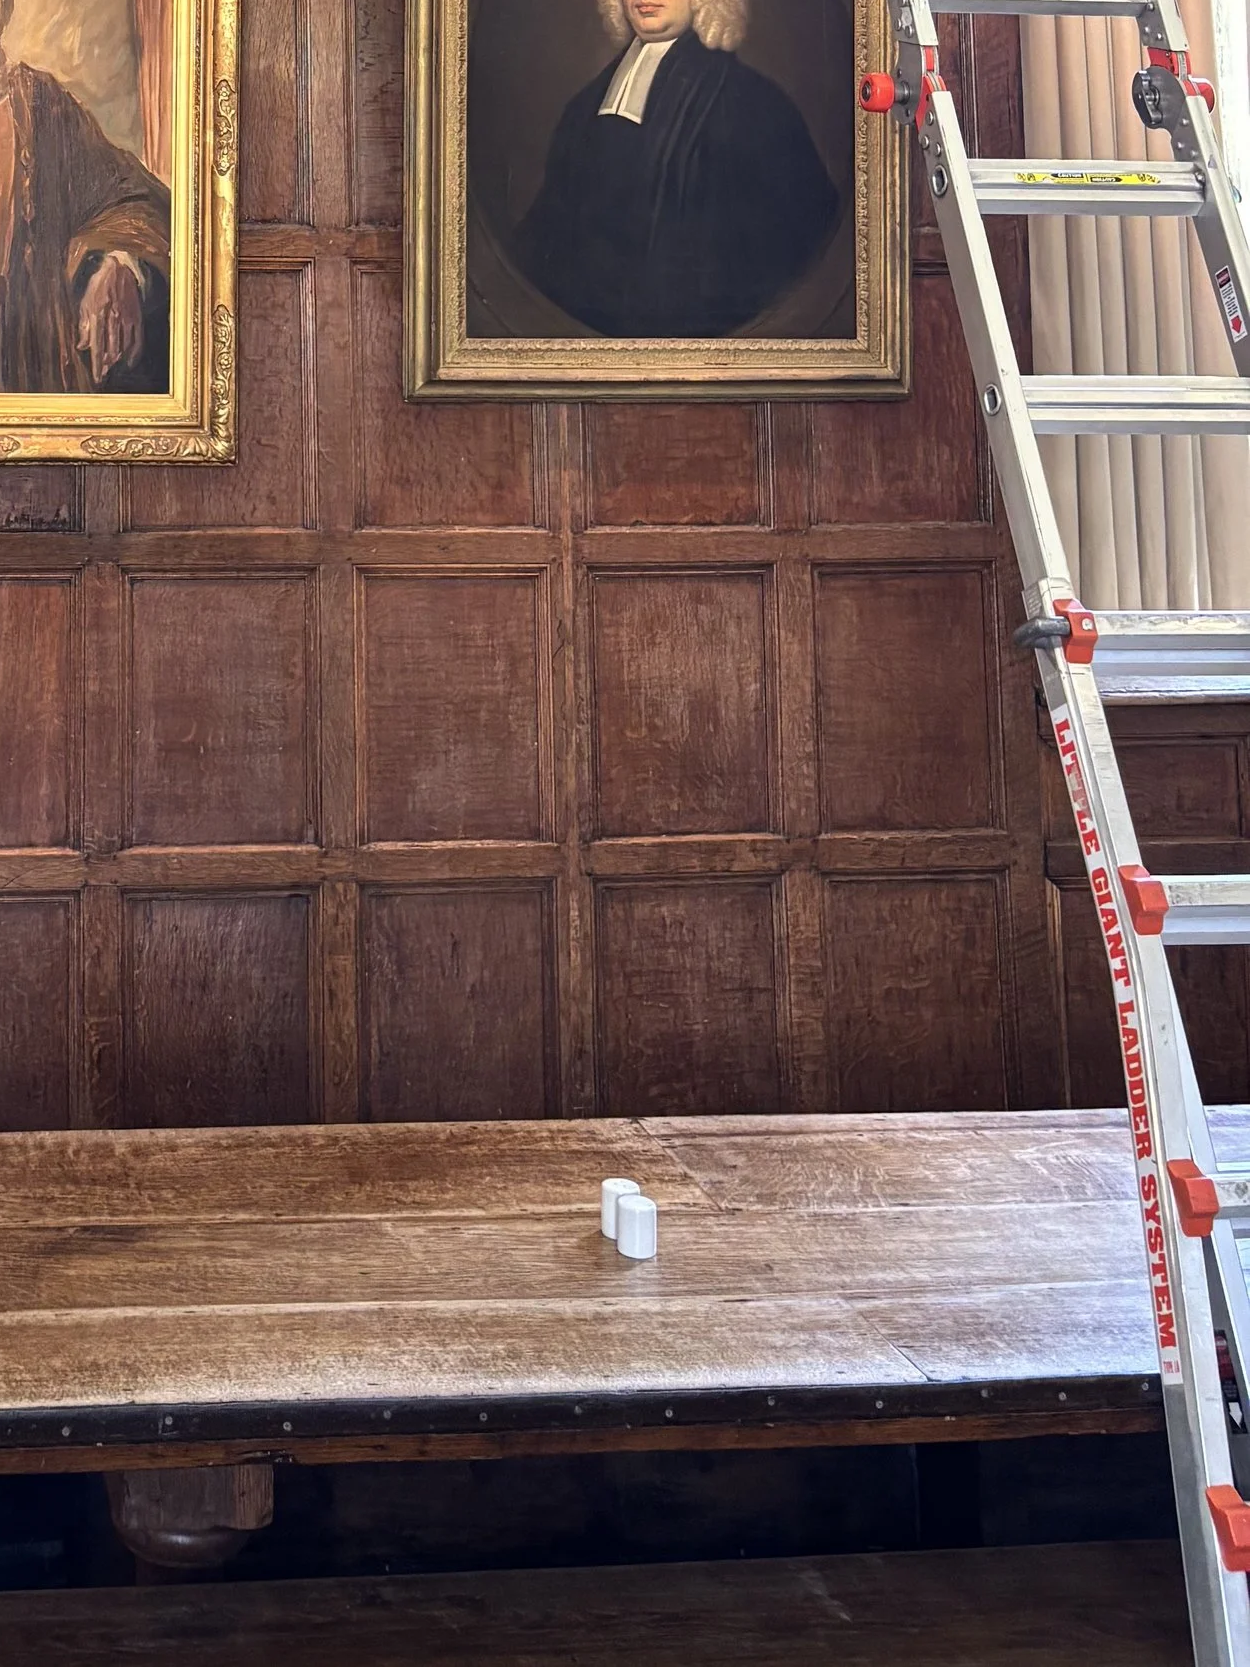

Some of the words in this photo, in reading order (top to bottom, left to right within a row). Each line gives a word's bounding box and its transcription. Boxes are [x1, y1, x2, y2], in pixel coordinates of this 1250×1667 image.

[1054, 717, 1101, 856] LITTLE
[1091, 866, 1132, 988] GIANT
[1118, 1001, 1153, 1161] LADDER
[1141, 1173, 1177, 1349] SYSTEM
